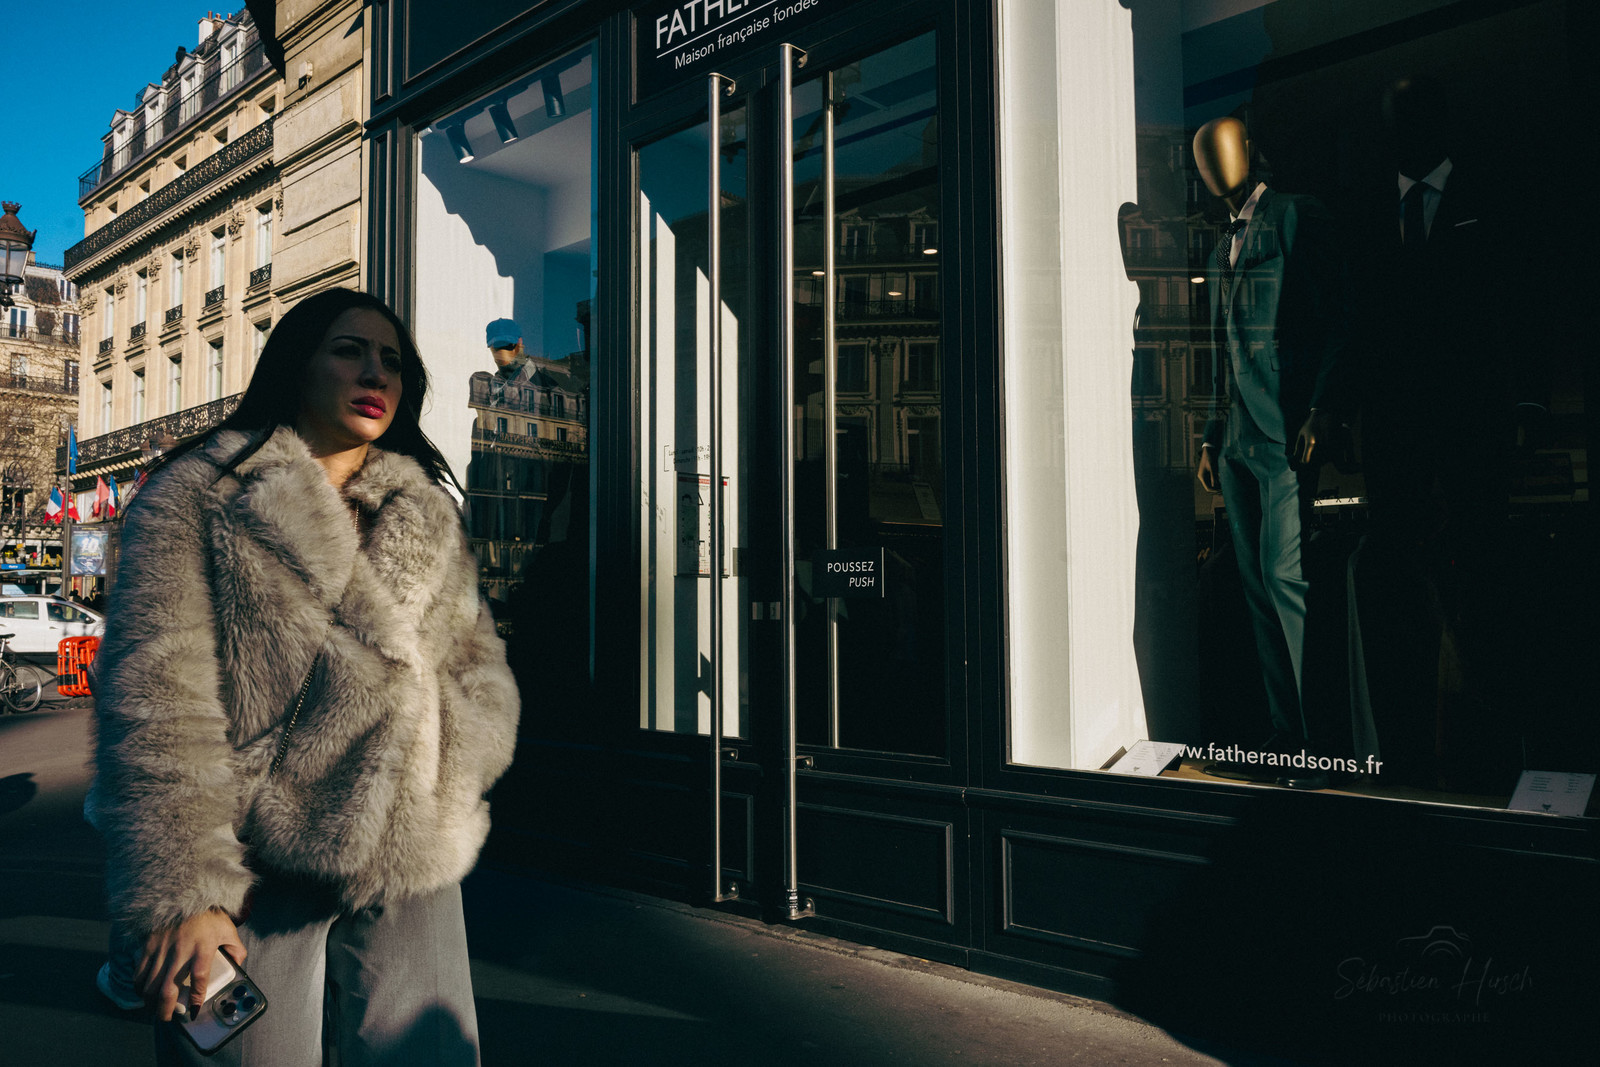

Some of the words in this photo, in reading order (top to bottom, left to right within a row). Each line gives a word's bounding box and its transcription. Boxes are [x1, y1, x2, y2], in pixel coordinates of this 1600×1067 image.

[656, 0, 749, 49] FATH
[674, 43, 715, 70] Maison
[717, 16, 770, 49] française
[827, 561, 874, 573] POUSSEZ
[849, 576, 875, 588] PUSH
